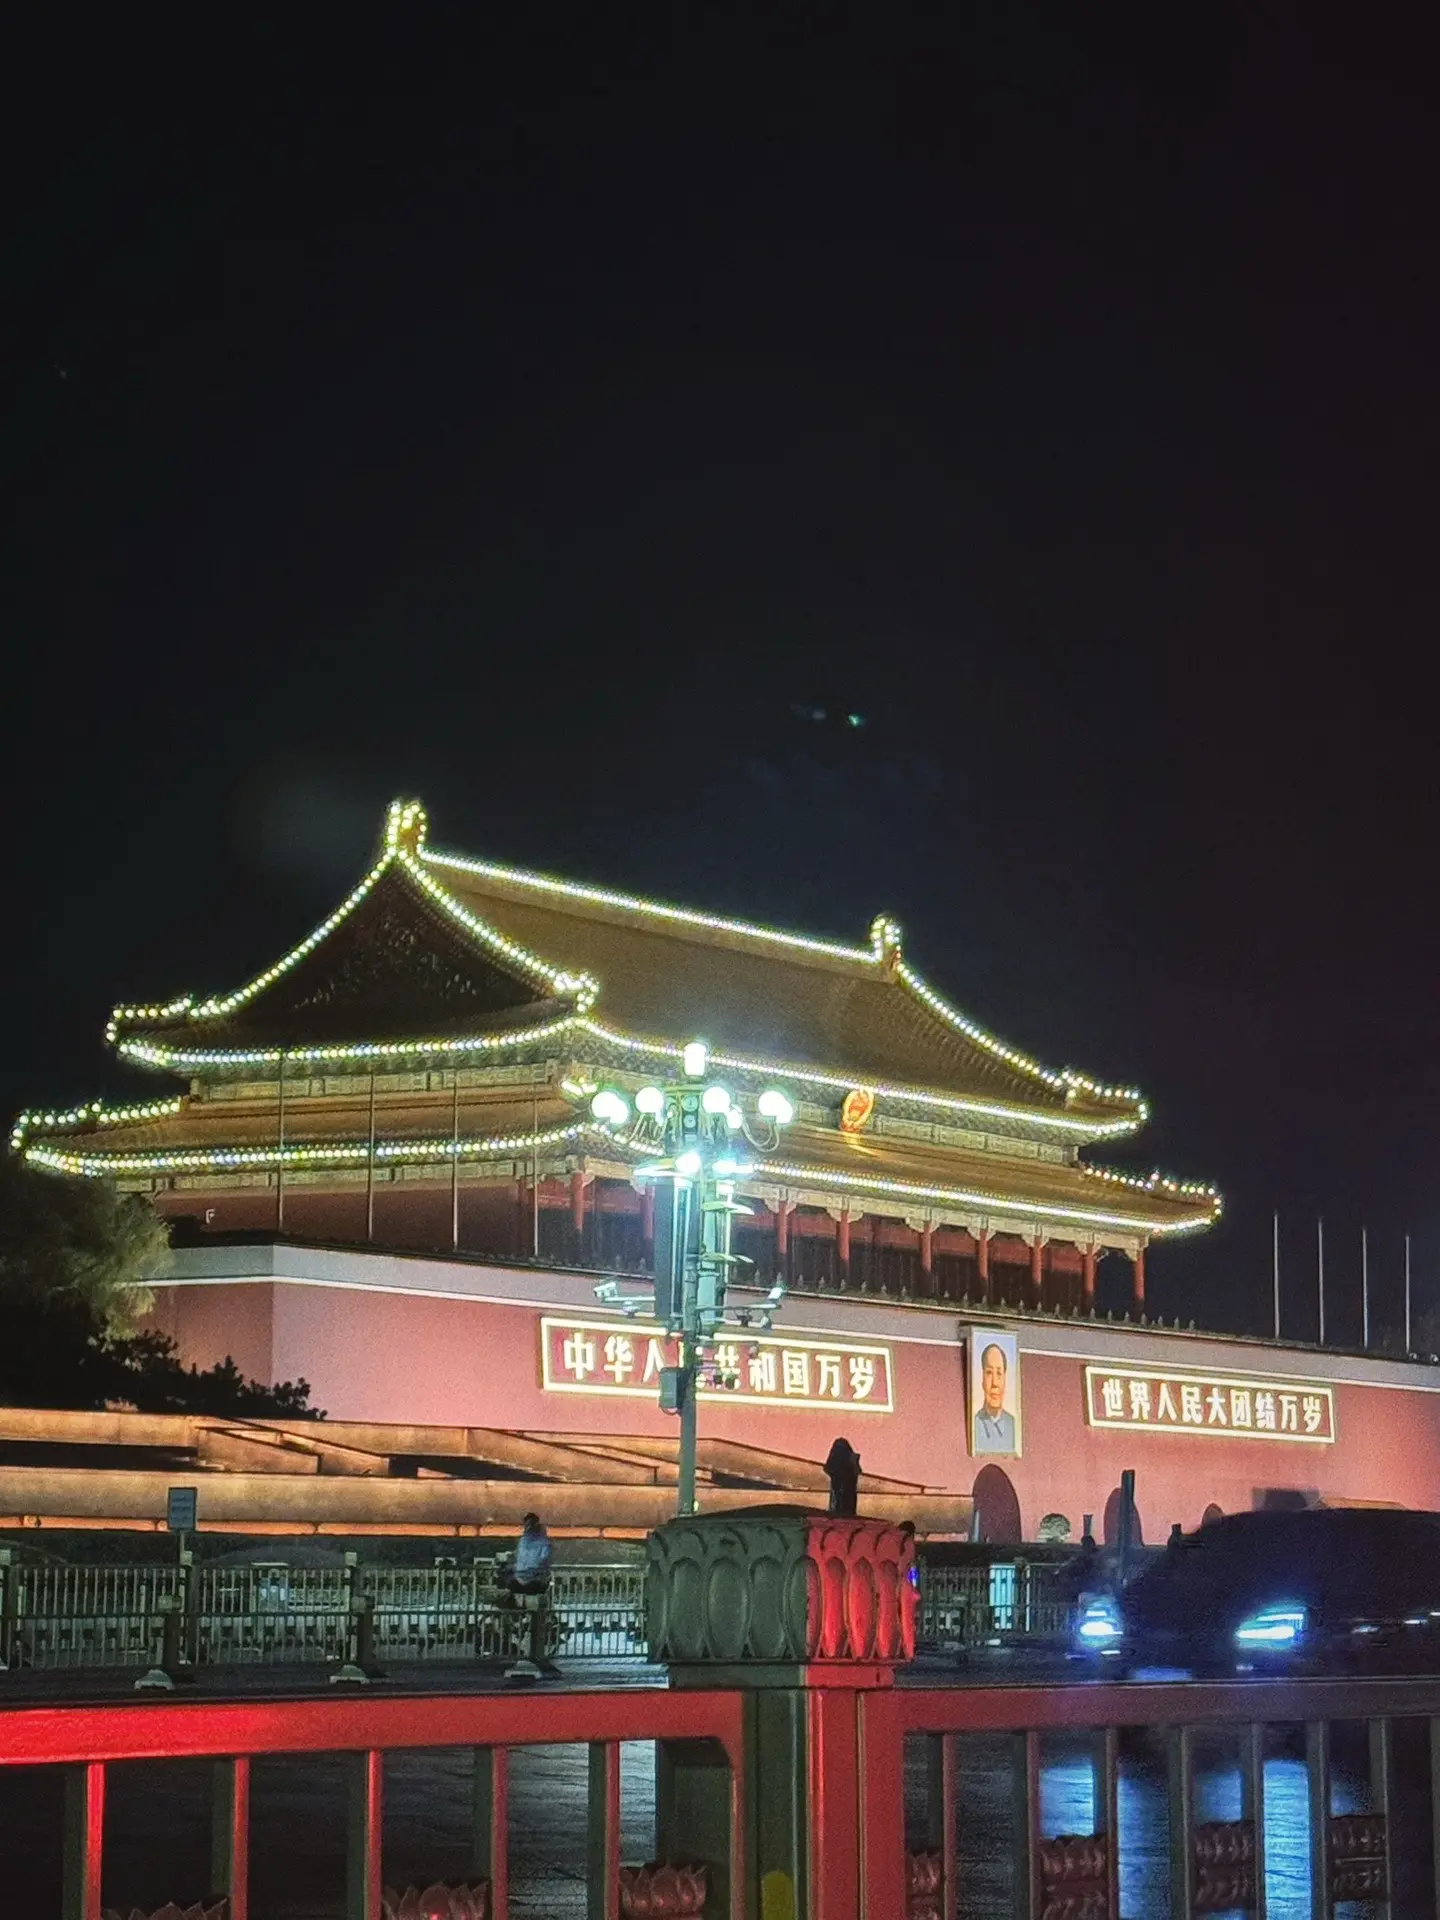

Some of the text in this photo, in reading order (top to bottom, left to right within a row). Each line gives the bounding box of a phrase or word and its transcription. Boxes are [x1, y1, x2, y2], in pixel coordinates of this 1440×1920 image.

[1102, 1378, 1321, 1432] 世界人民大团结万岁
